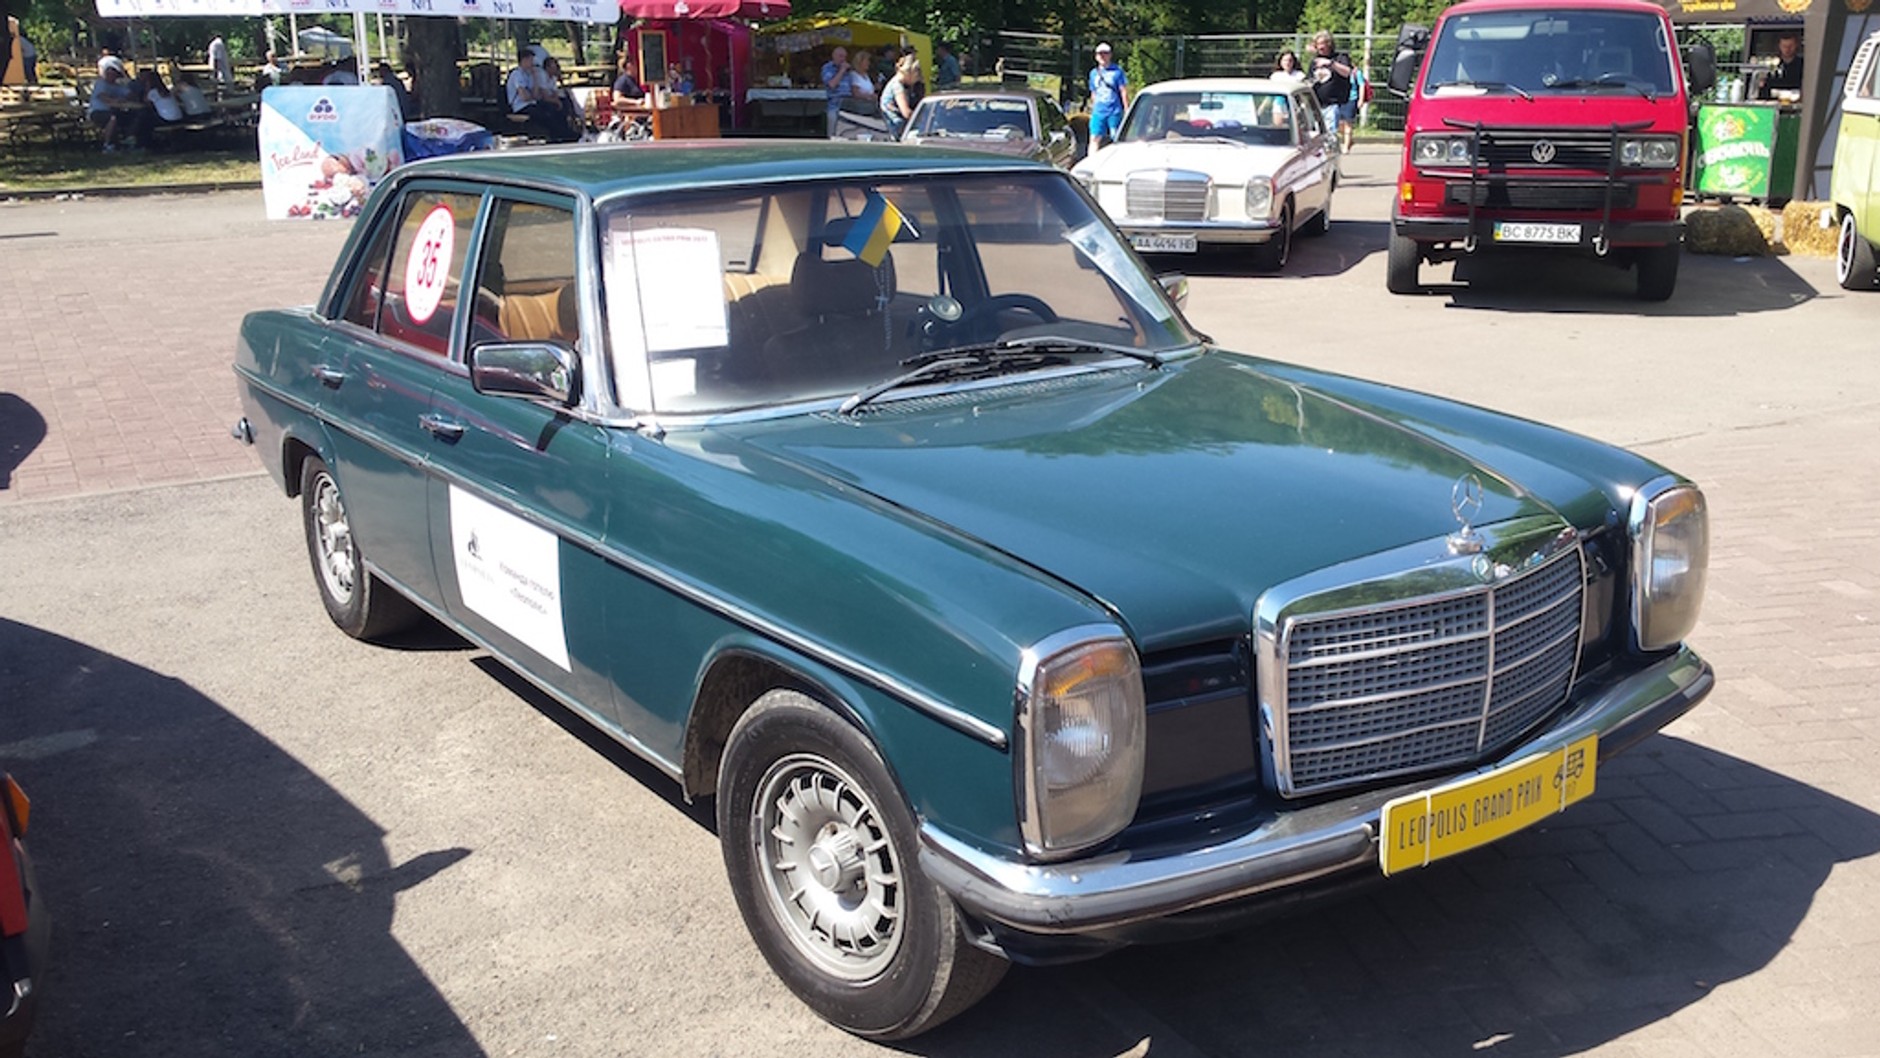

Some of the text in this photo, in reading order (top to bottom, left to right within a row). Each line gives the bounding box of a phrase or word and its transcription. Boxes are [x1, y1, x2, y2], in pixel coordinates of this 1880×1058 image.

[1503, 225, 1577, 240] BC 8775 BK
[417, 240, 441, 288] 35
[1399, 774, 1543, 850] LEOPOLIS GRAND PRIX
